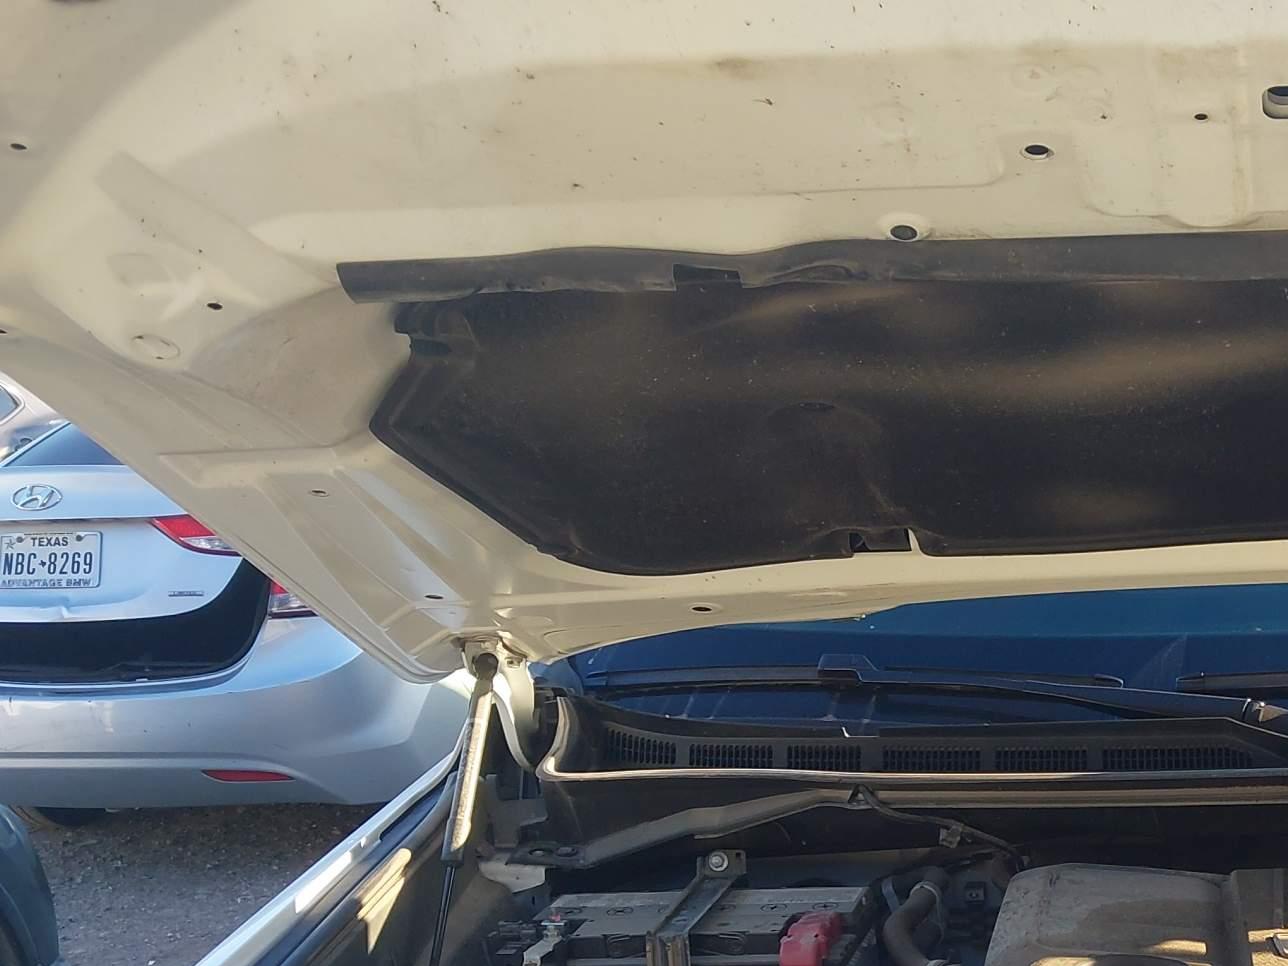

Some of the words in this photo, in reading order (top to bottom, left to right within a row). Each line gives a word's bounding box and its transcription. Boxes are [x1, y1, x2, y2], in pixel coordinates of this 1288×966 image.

[30, 536, 69, 547] TEXAS
[2, 552, 37, 575] NBC
[47, 551, 93, 575] 8269
[0, 578, 63, 588] ADVANTAGE
[65, 578, 92, 587] BMW
